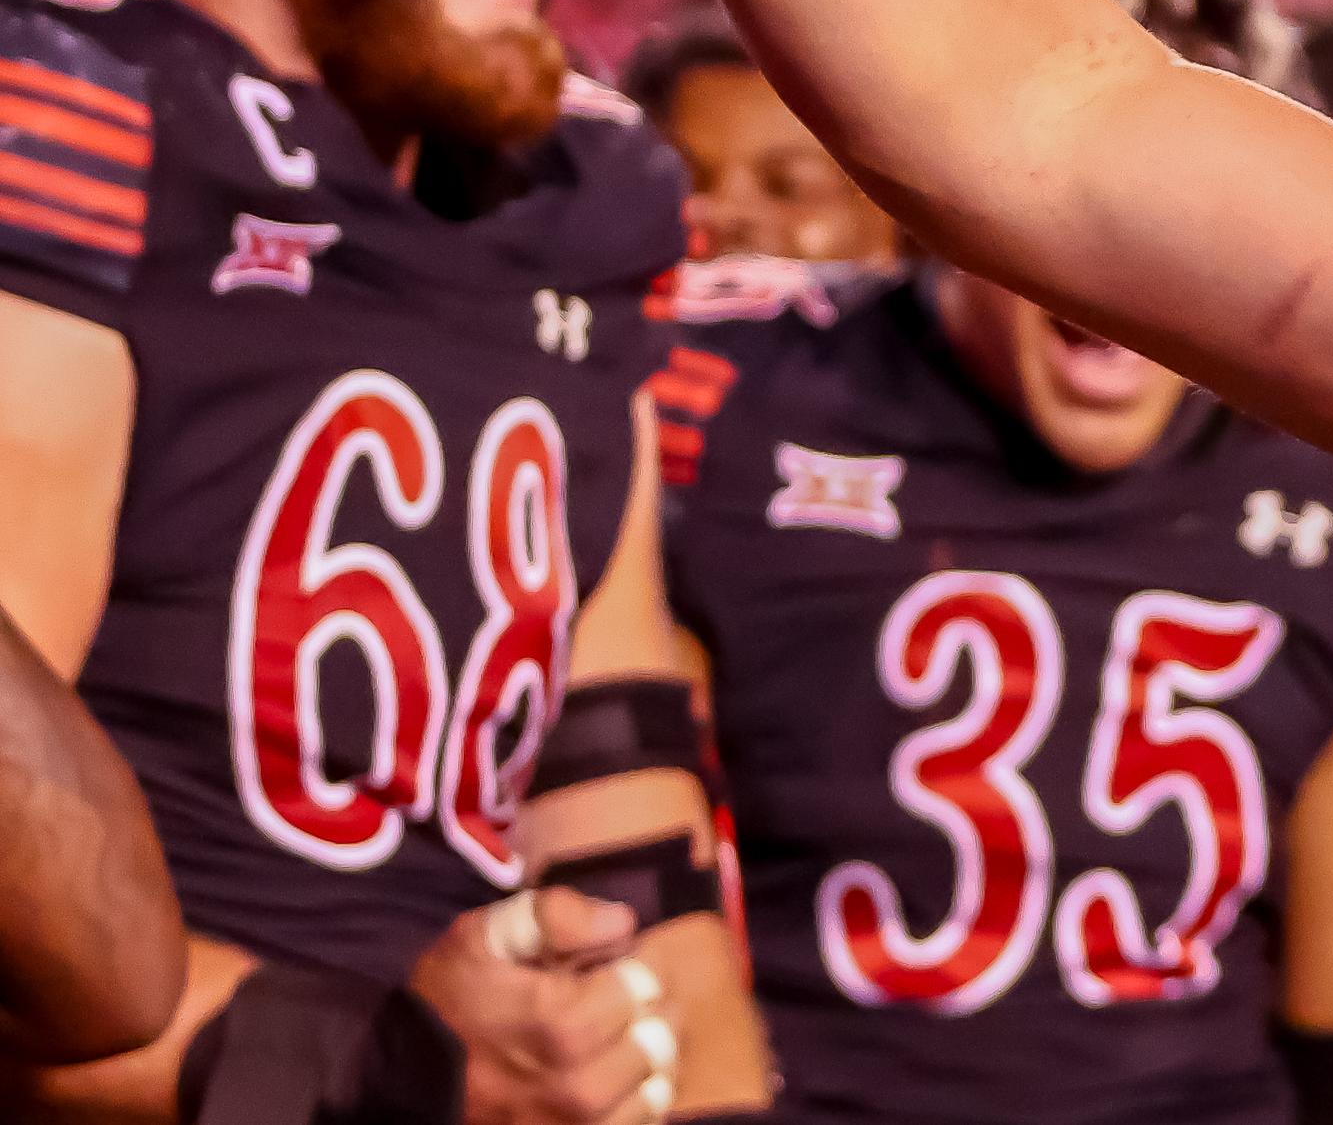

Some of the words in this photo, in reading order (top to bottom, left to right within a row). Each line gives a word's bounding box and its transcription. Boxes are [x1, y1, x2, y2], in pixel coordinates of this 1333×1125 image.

[228, 73, 317, 189] C
[228, 368, 577, 887] 68
[815, 570, 1286, 1014] 35
